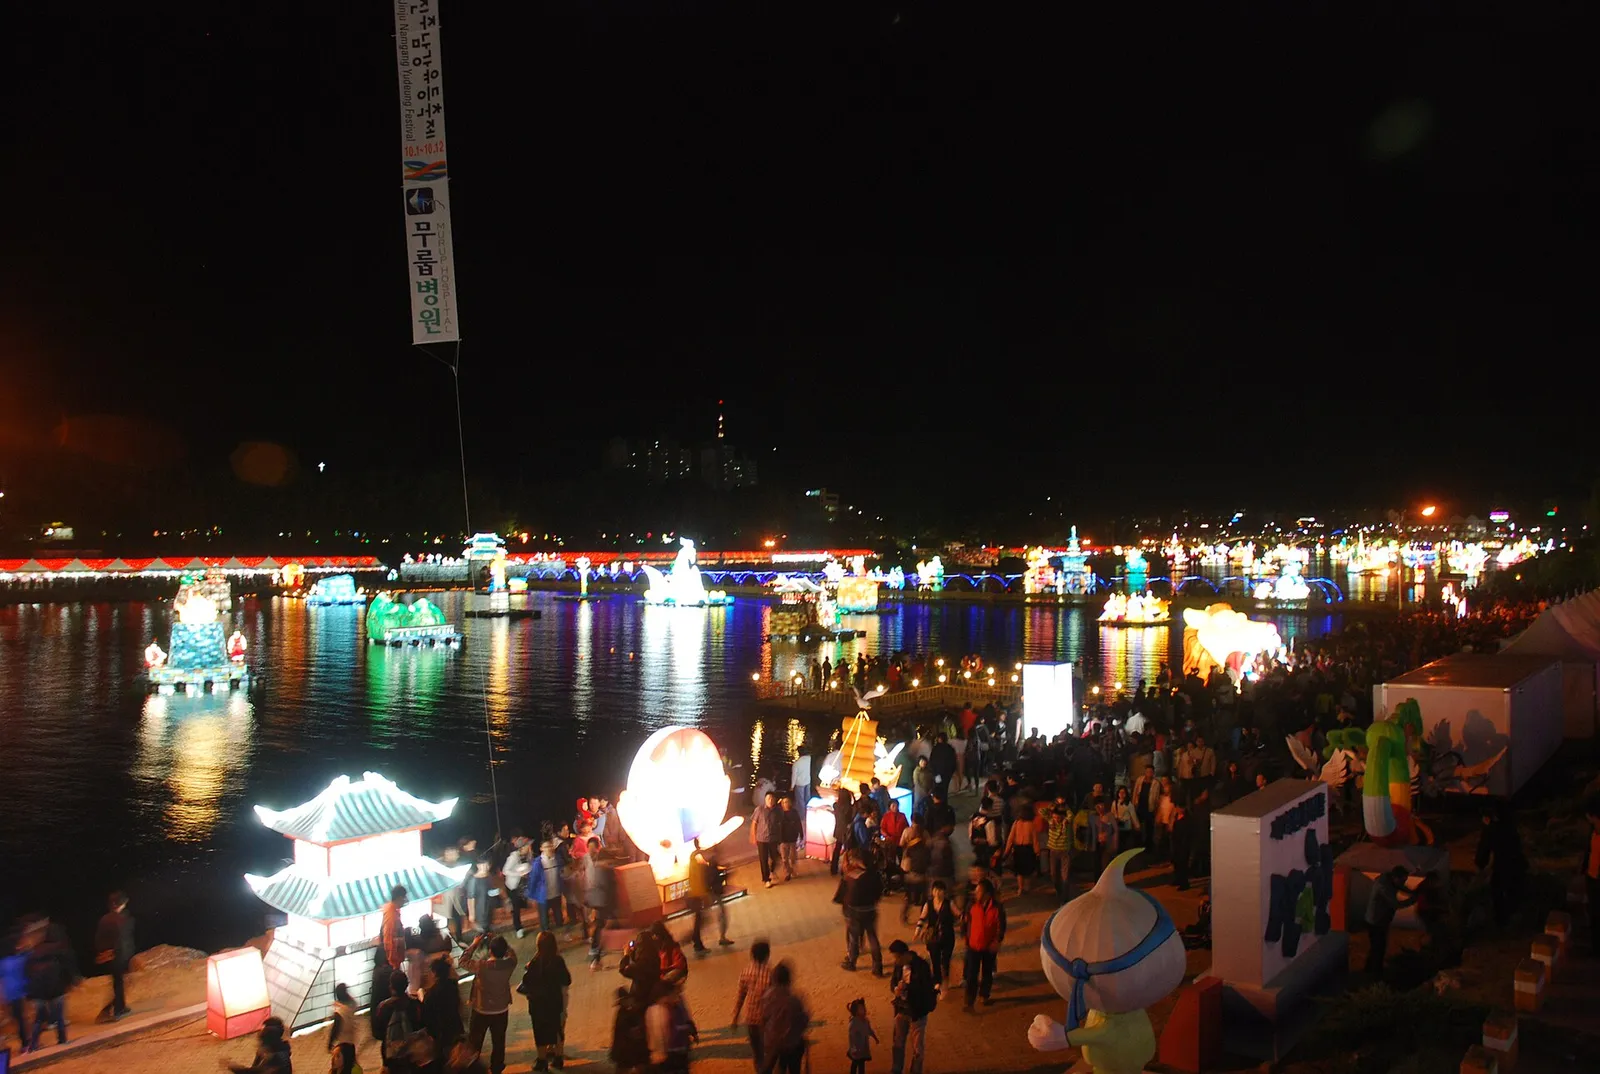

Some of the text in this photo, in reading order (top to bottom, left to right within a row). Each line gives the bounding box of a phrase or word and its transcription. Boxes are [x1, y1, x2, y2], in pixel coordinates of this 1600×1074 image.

[399, 23, 411, 67] Namgang
[402, 69, 413, 107] Yudeung
[404, 108, 416, 142] Festival
[441, 266, 453, 333] HOSPITAL
